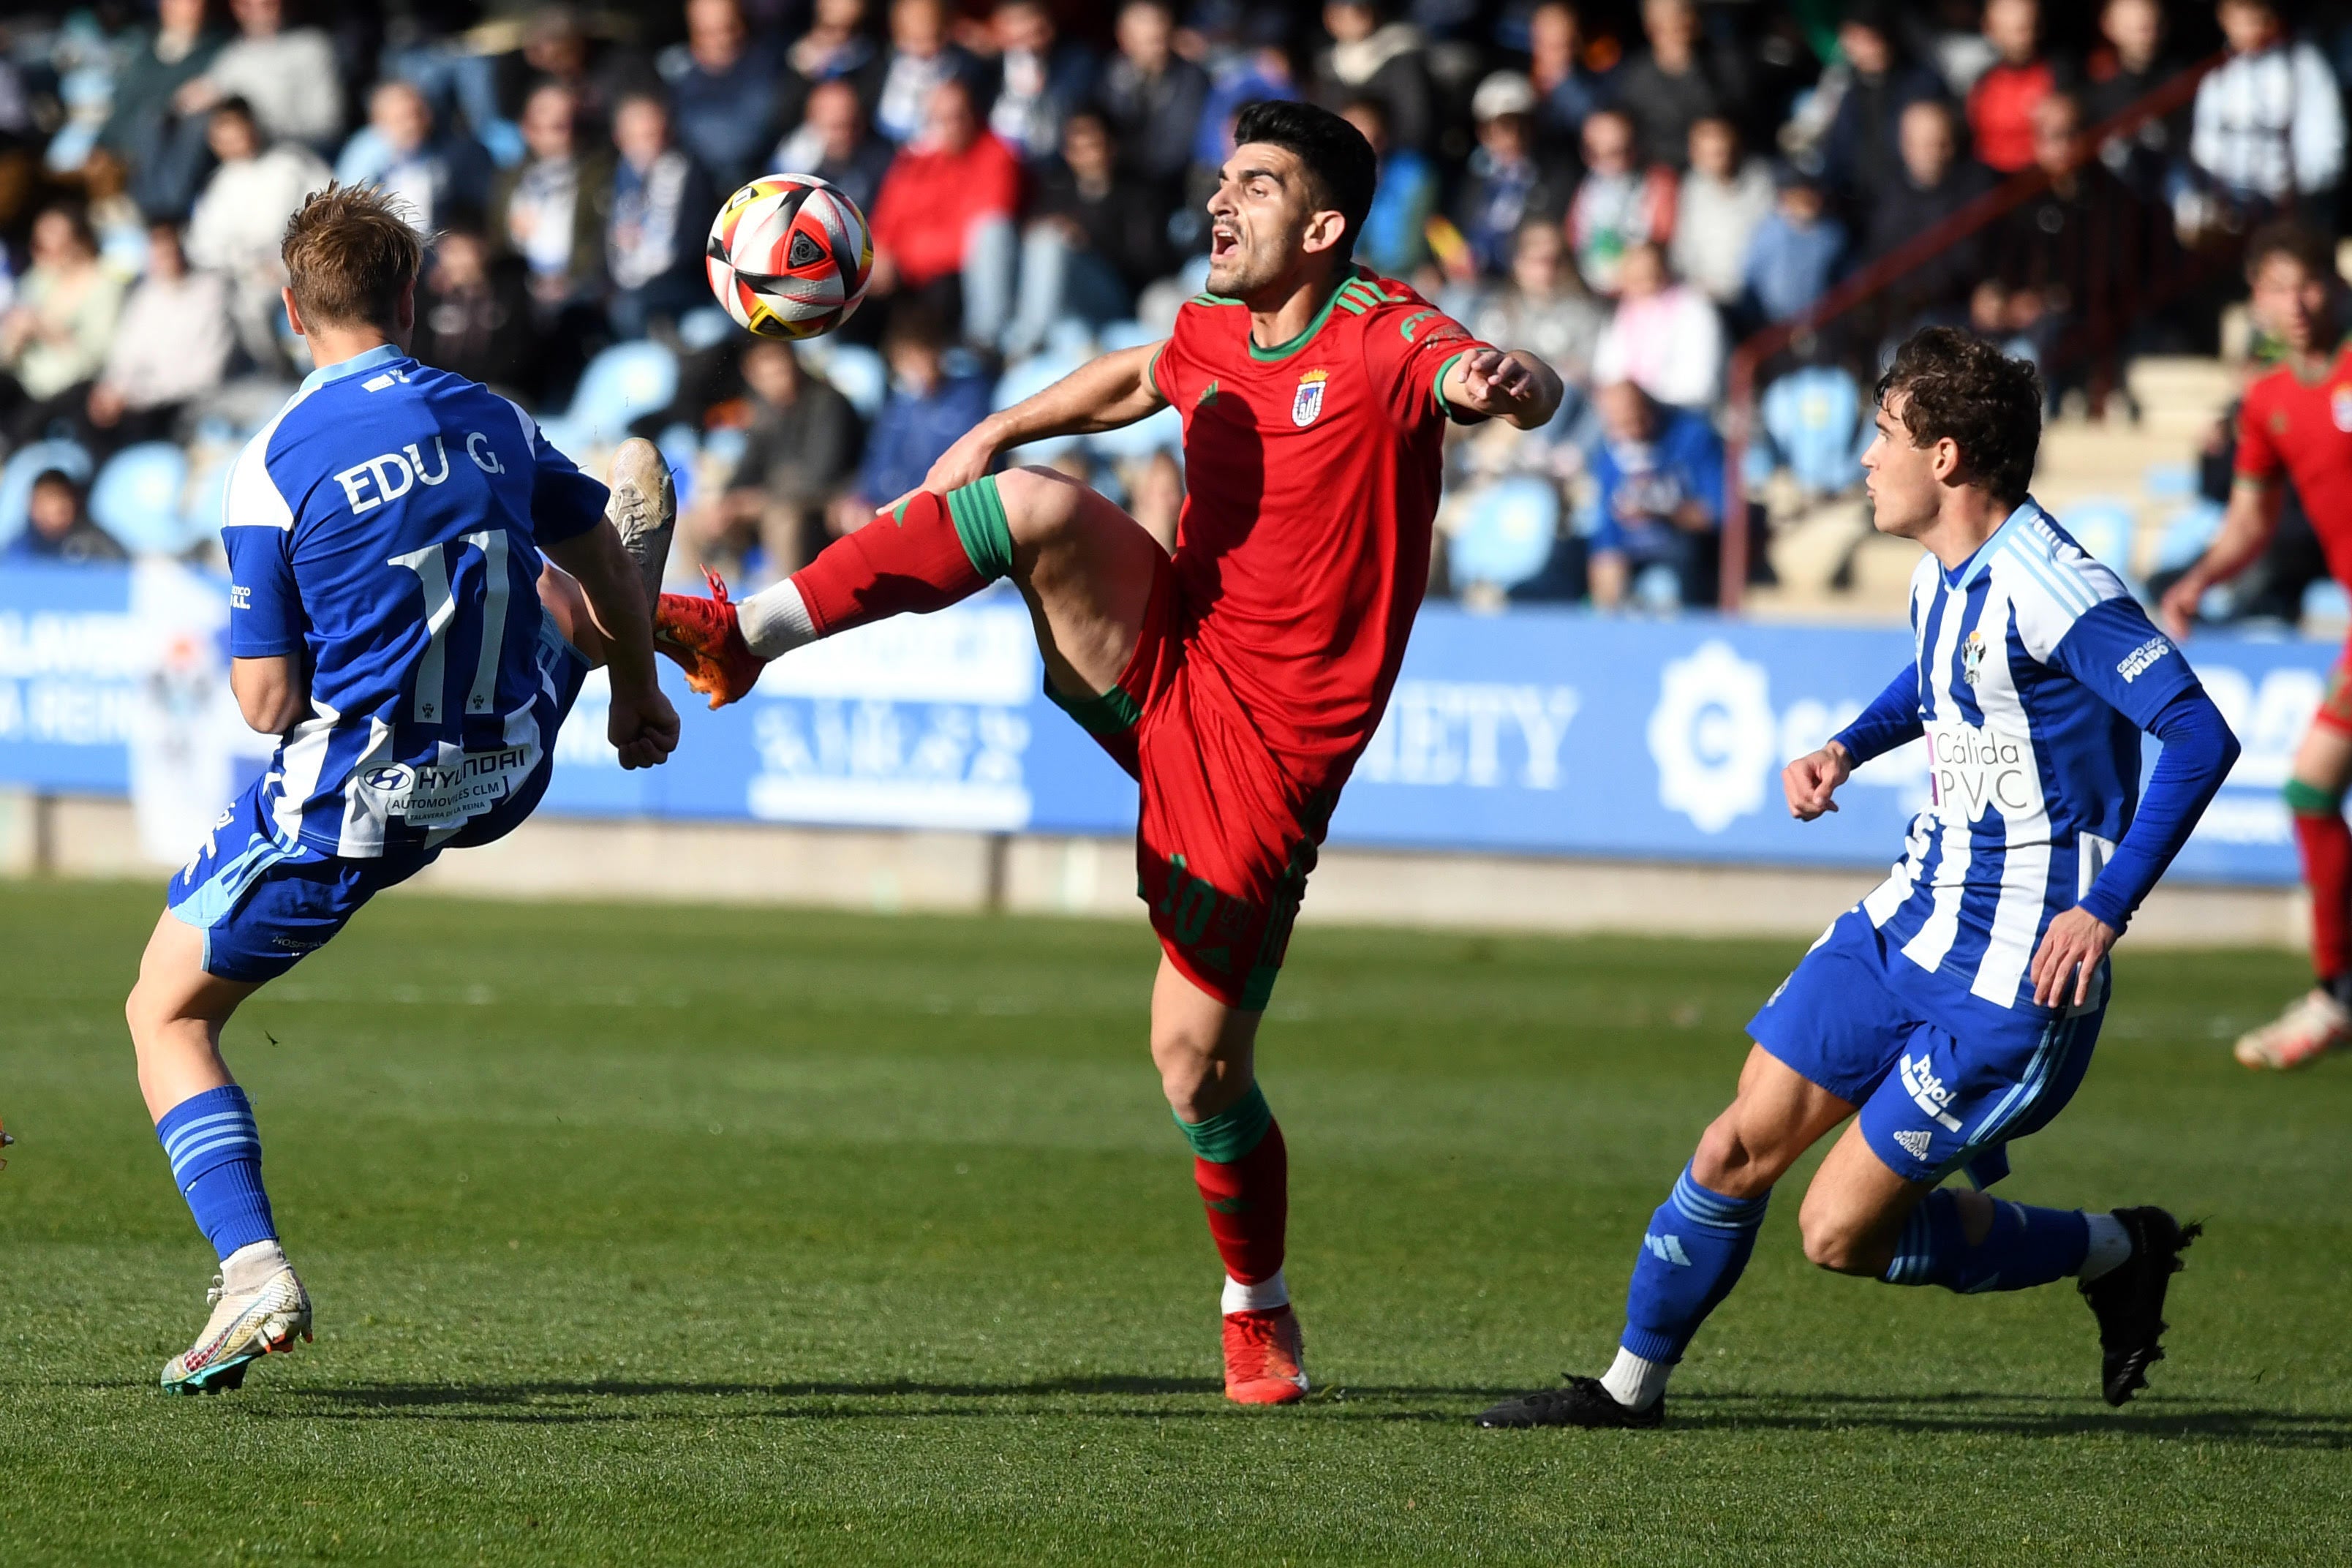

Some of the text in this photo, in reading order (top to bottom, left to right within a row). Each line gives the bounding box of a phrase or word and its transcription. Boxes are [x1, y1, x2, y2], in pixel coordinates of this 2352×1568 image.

[333, 432, 505, 515] EDU G.
[387, 529, 510, 724] 11
[2117, 647, 2144, 673] GRUPO
[2122, 644, 2169, 684] PULIDO
[1937, 732, 2019, 766] Cálida
[418, 749, 525, 790] HYUNDAI
[1941, 769, 2027, 810] PVC
[391, 782, 500, 810] AUTOMOVILES CLM
[462, 801, 486, 811] REINA
[1159, 853, 1217, 945] 10
[1912, 1054, 1958, 1108] Pujol
[1893, 1131, 1929, 1161] adidas
